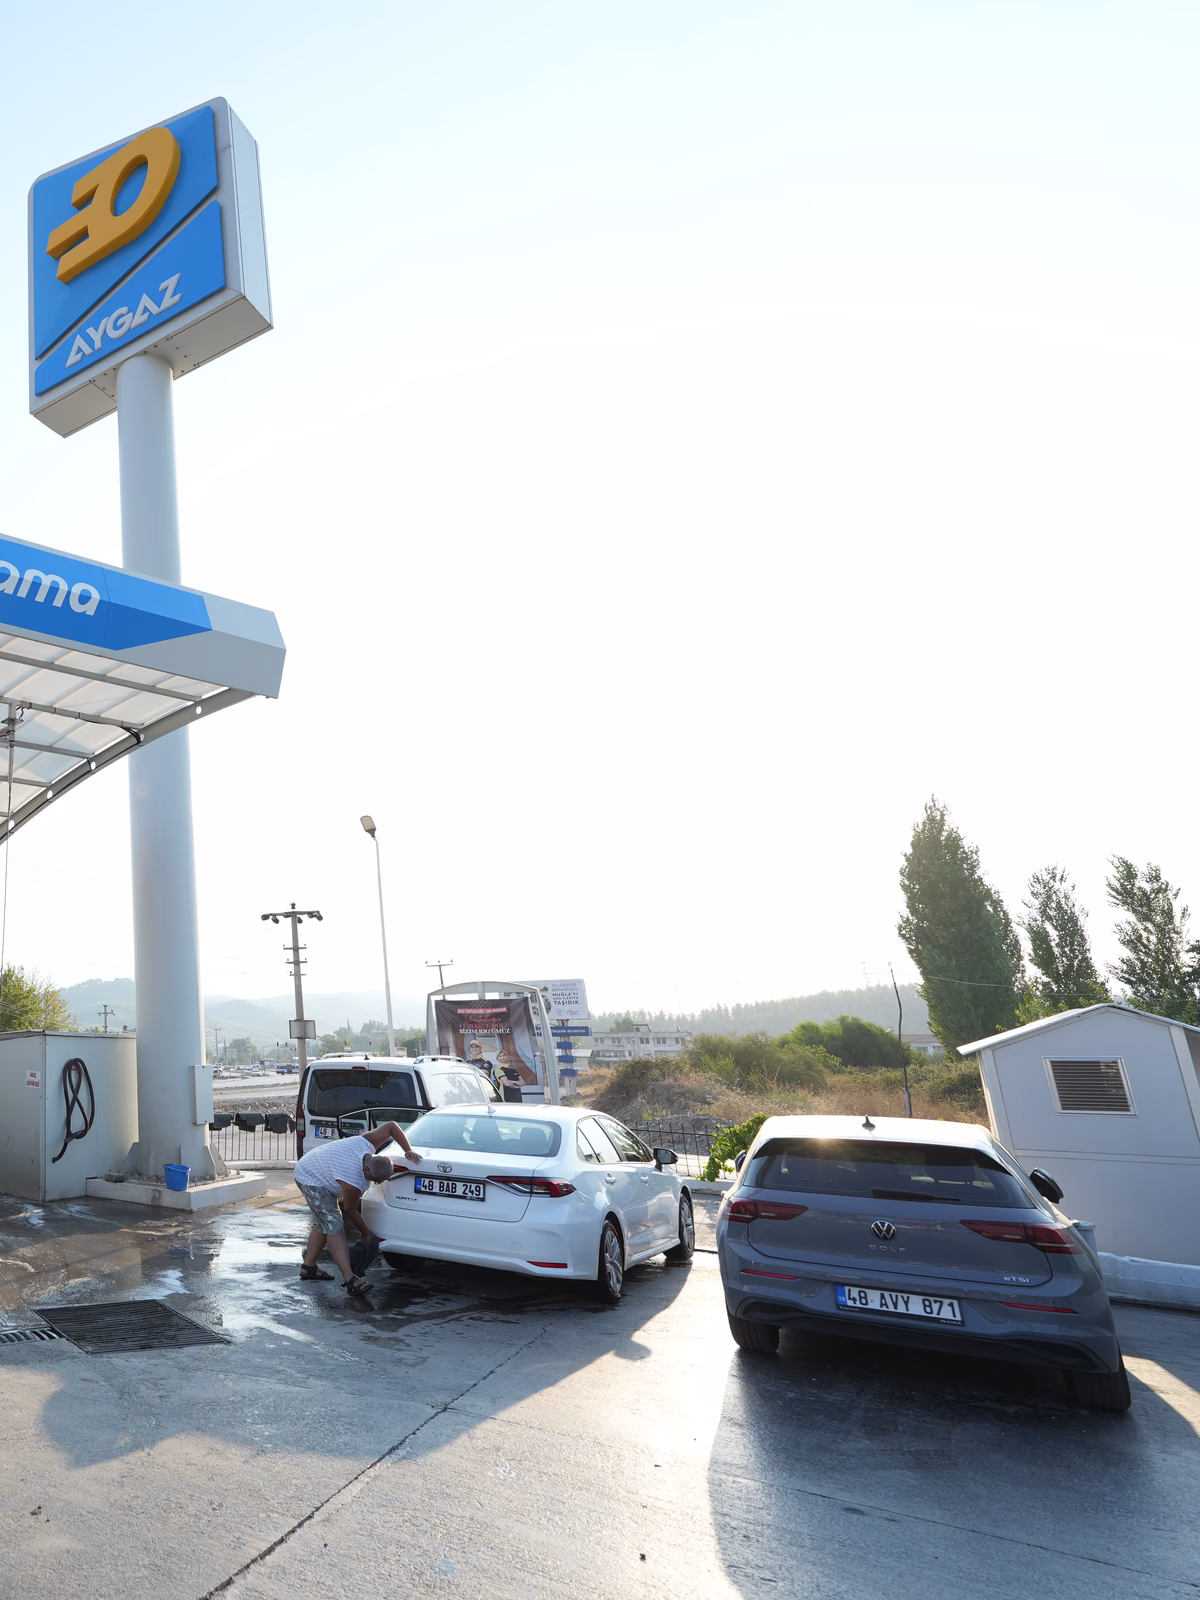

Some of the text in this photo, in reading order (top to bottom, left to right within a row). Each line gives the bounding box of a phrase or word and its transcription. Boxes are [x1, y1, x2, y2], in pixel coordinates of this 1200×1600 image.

[65, 272, 182, 369] AYGAZ
[320, 1127, 328, 1136] 48
[422, 1179, 434, 1191] 48
[438, 1181, 457, 1194] BAB
[462, 1183, 481, 1197] 249
[868, 1244, 905, 1252] GOLF
[847, 1288, 869, 1306] 48
[880, 1292, 910, 1312] AVY
[921, 1297, 957, 1319] 871
